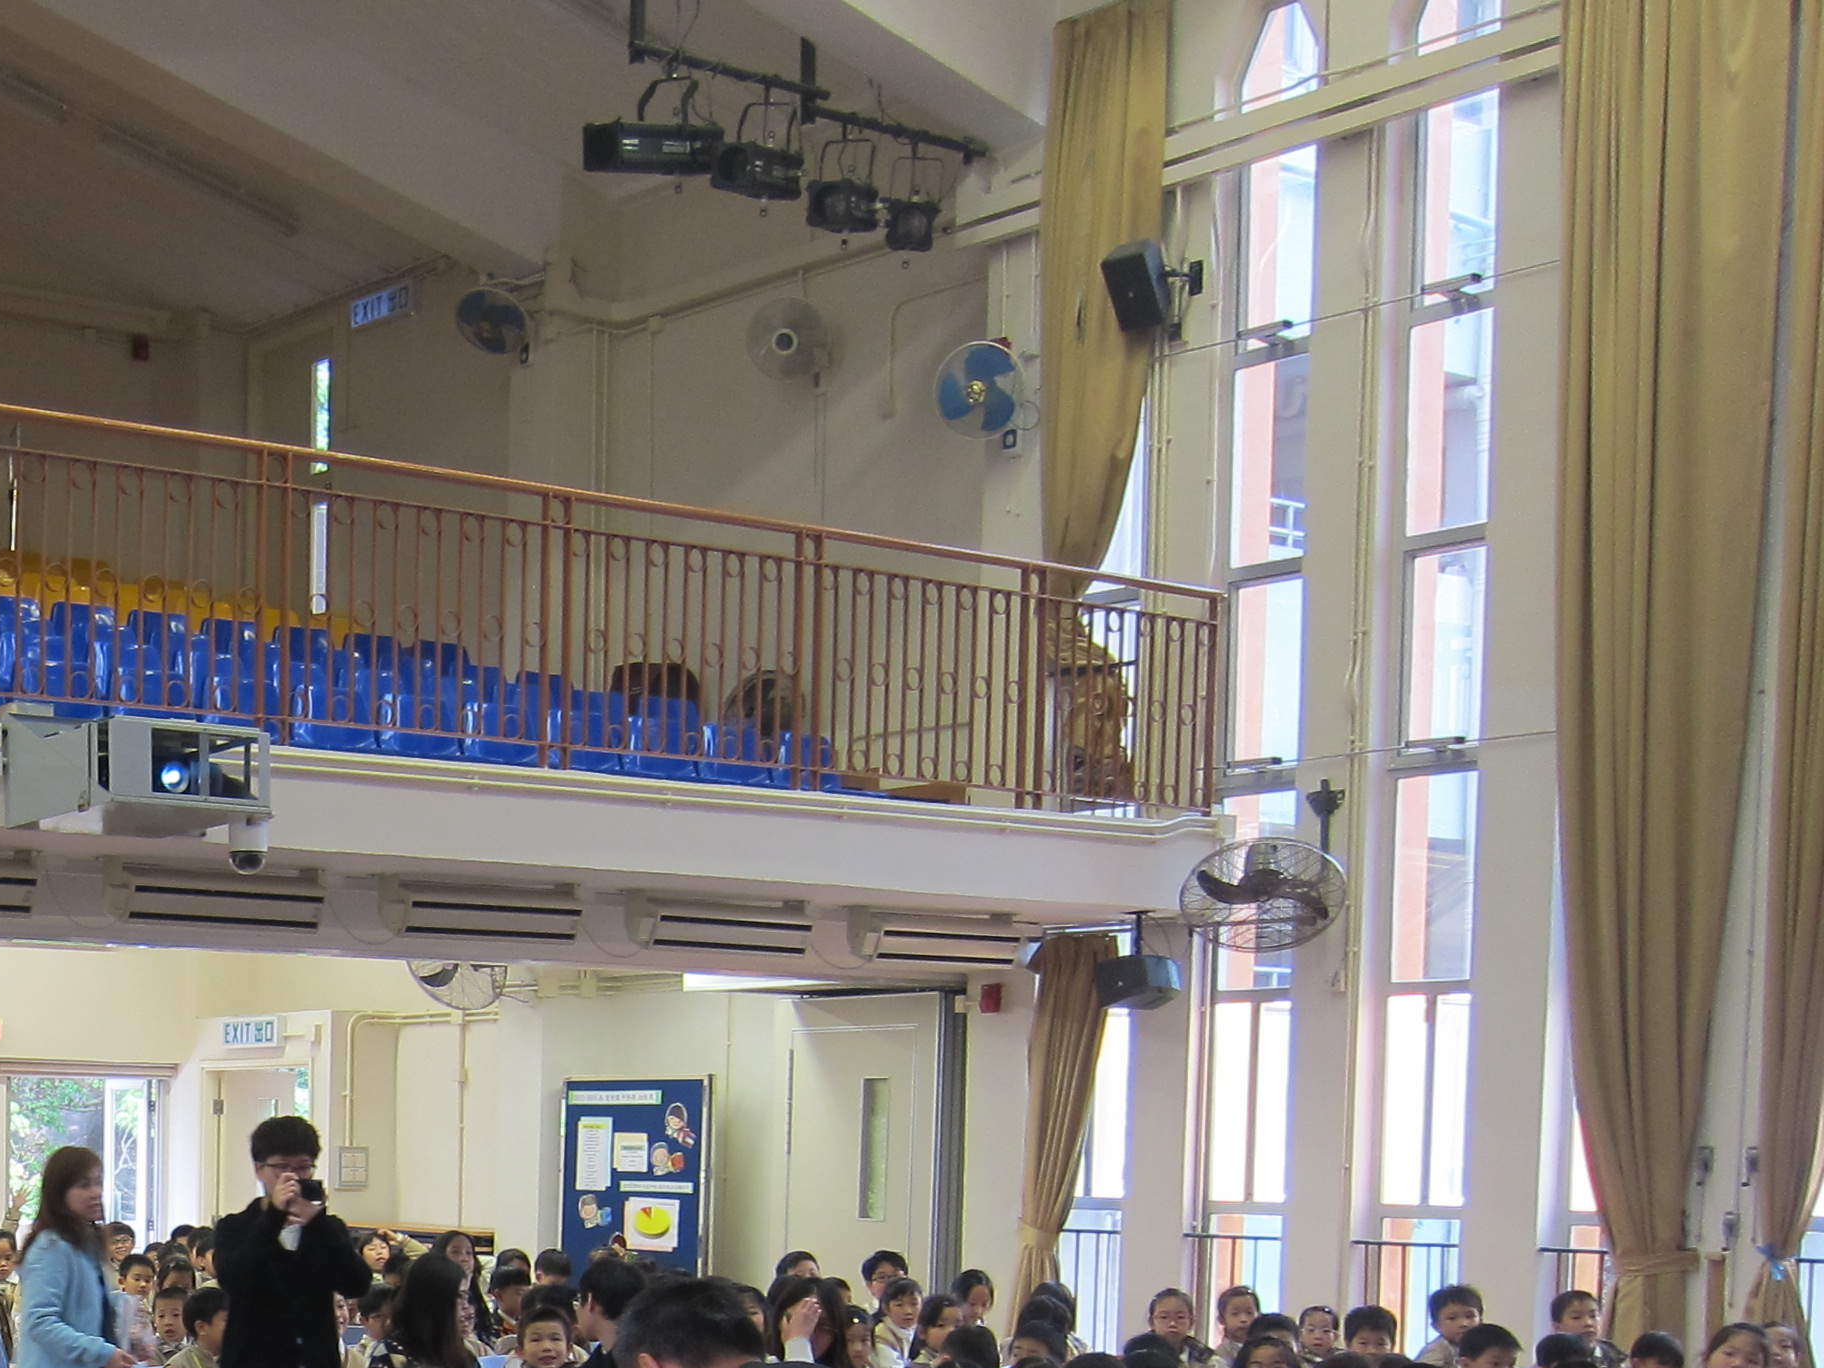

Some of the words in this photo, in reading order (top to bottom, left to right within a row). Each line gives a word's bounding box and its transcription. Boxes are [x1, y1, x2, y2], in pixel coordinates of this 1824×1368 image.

[353, 295, 384, 325] EXIT
[225, 1022, 251, 1043] EXIT
[255, 1021, 273, 1042] 出口
